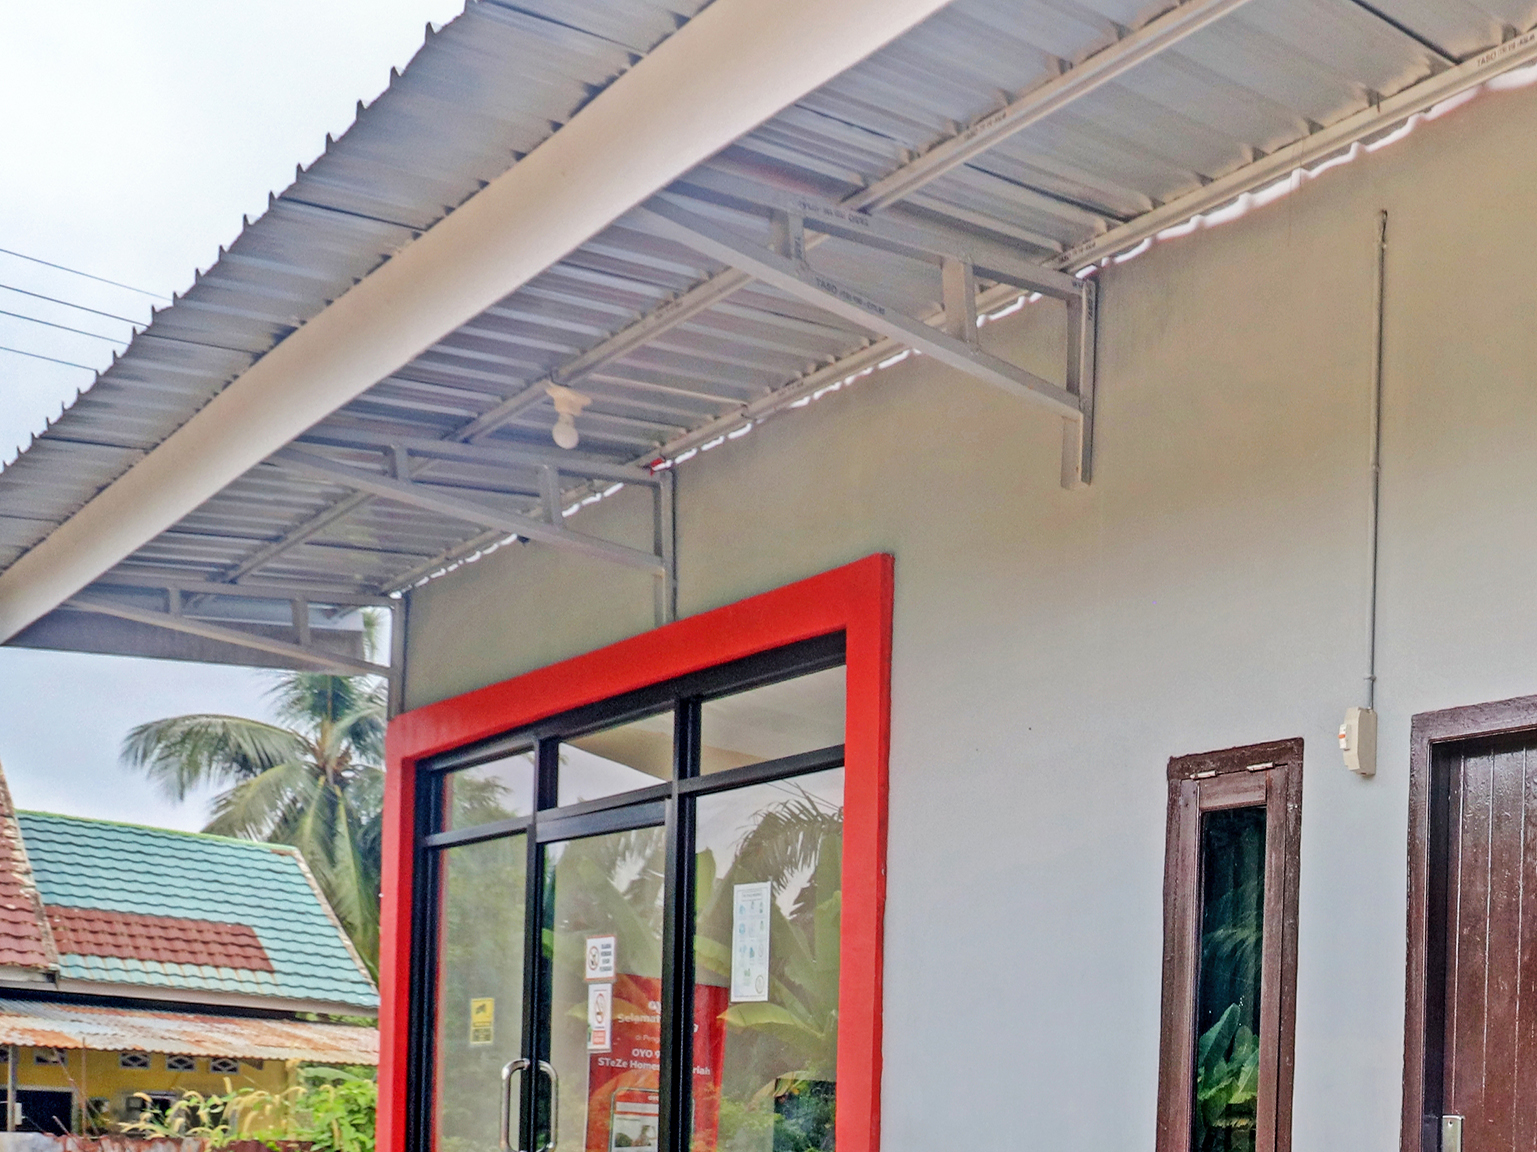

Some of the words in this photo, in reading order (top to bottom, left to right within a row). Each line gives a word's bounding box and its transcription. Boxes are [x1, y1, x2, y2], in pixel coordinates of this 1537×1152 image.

[632, 1048, 653, 1058] OYO
[598, 1057, 628, 1068] STeZe
[630, 1060, 660, 1071] Homes
[692, 1066, 711, 1076] riah
